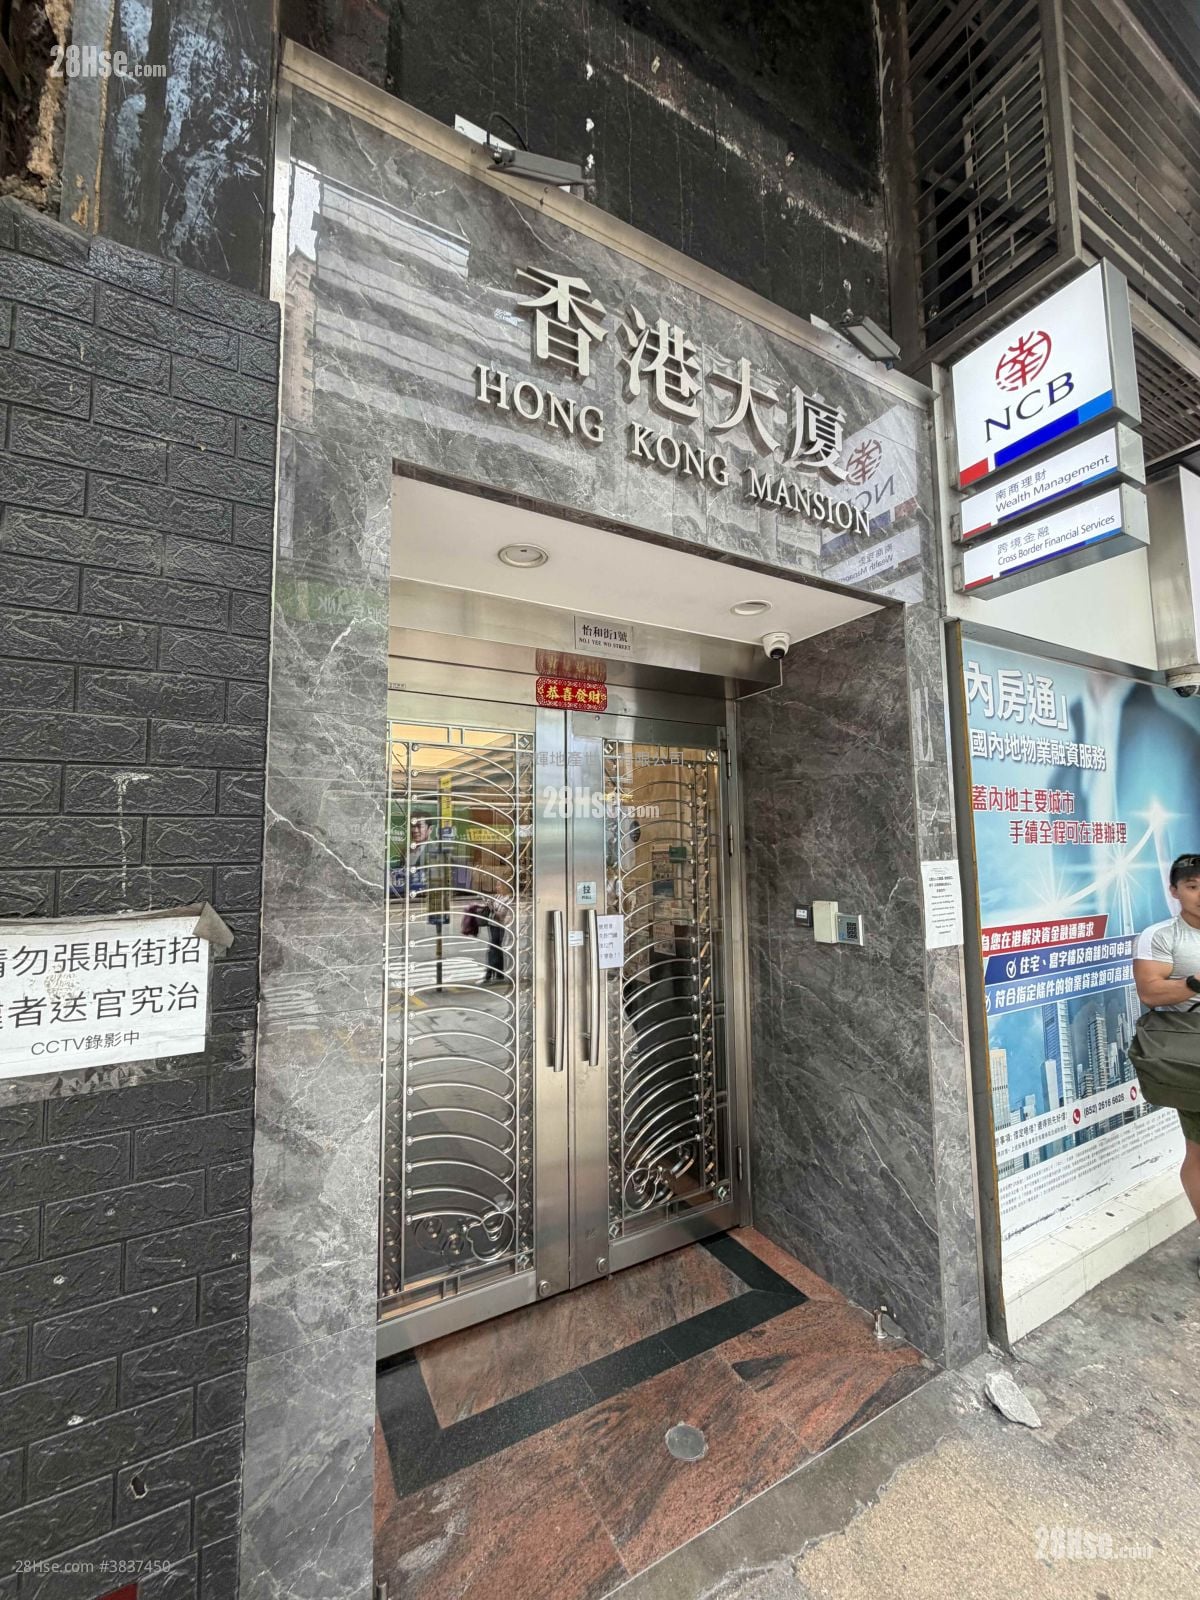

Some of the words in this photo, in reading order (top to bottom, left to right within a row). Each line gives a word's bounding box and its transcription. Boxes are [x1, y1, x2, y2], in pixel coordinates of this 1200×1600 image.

[516, 265, 850, 486] 香港大廈
[984, 371, 1075, 443] NCB
[475, 364, 606, 443] HONG
[631, 421, 730, 487] KONG
[747, 470, 872, 538] MANSION
[995, 491, 1031, 513] Wealth
[1033, 454, 1110, 497] Management
[995, 468, 1047, 502] 南商理財
[997, 526, 1050, 556] 跨境金融
[998, 552, 1017, 566] Cross
[1018, 542, 1043, 558] Border
[1044, 526, 1080, 549] Financial
[1081, 515, 1115, 535] Services
[613, 643, 631, 651] STREET
[0, 936, 201, 978] 勿張貼街招
[0, 981, 200, 1030] 者送官究治
